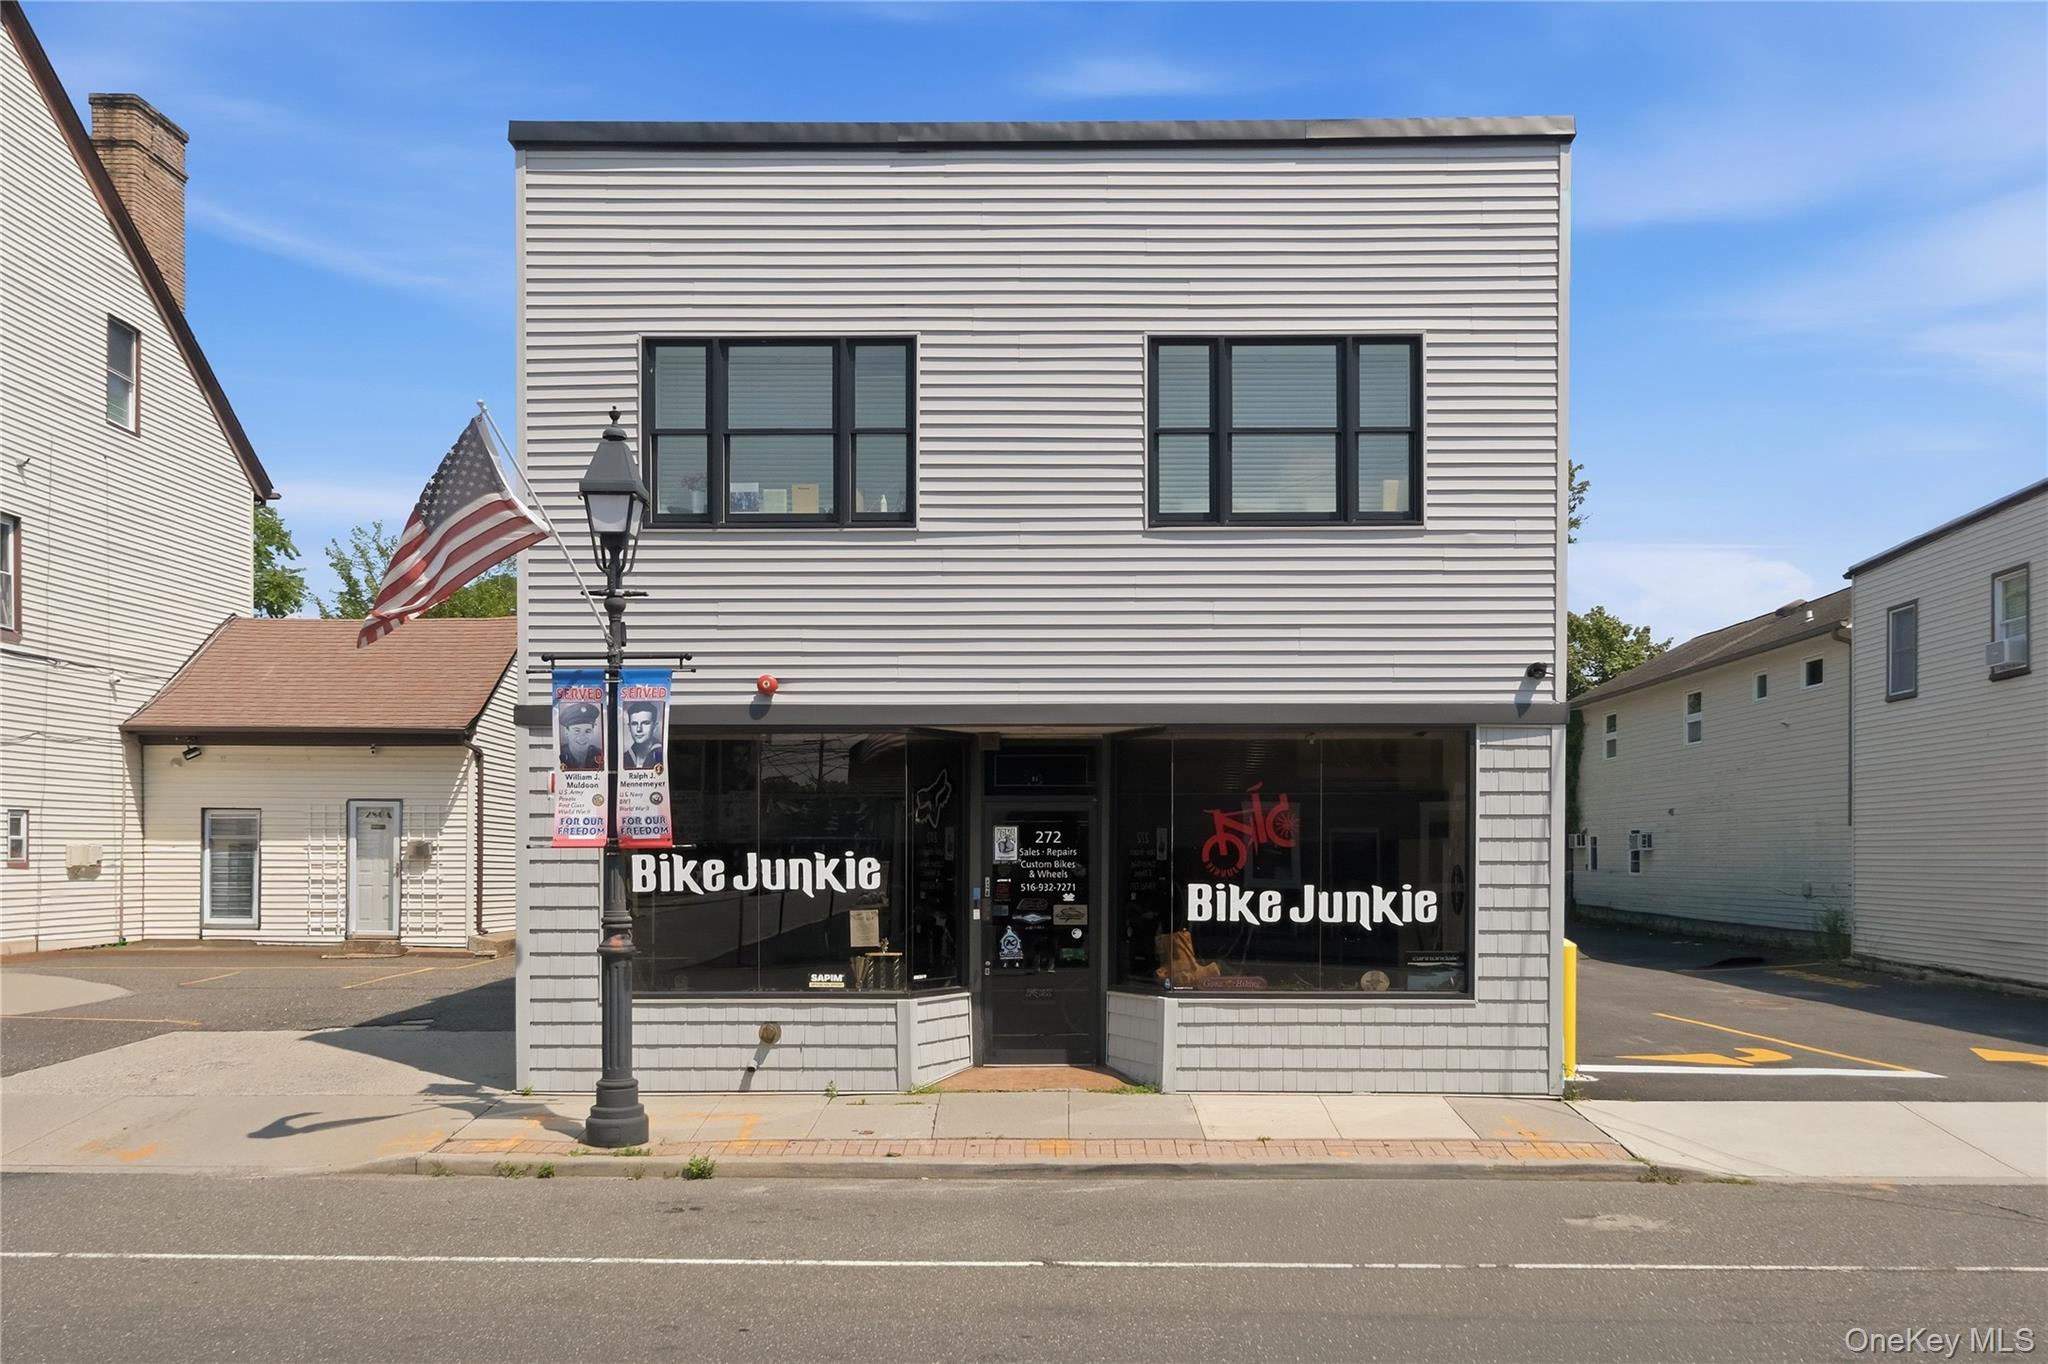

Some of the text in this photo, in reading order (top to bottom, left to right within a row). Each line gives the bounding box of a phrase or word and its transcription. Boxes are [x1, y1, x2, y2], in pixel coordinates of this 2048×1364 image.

[556, 687, 603, 700] SERVED
[621, 687, 667, 699] SERVED
[629, 772, 648, 780] Ralph
[560, 817, 603, 826] FOR OUR
[622, 816, 666, 825] FOR OUR
[558, 827, 605, 836] FREEDOM
[621, 826, 668, 835] FREEDOM
[1035, 831, 1062, 844] 272
[1019, 848, 1040, 856] Sales
[1046, 847, 1077, 857] Repairs
[1020, 860, 1076, 869] Custom Bikes
[632, 850, 881, 899] Bike Junkie
[1029, 870, 1068, 878] & Wheels
[1020, 883, 1076, 892] 516-932-7271
[1187, 883, 1438, 931] Bike Junkie
[811, 973, 844, 982] SAPIM
